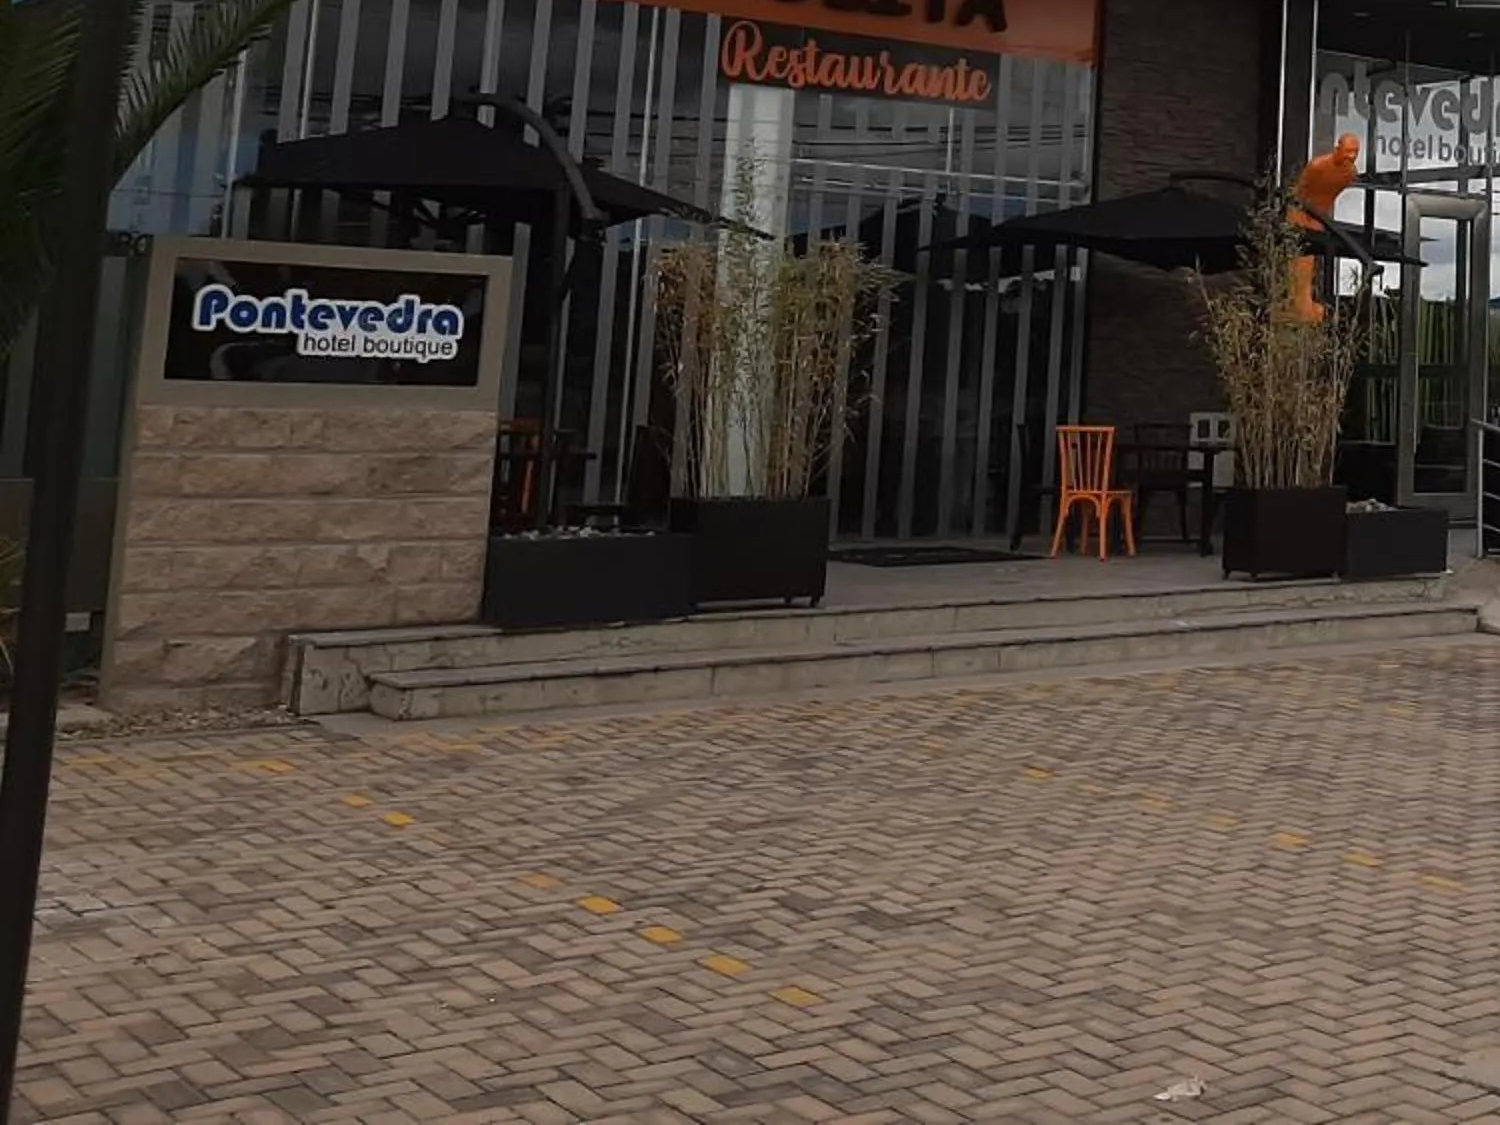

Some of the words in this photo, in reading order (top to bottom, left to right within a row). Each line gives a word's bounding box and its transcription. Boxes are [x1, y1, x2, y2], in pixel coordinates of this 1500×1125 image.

[721, 19, 992, 102] Restaurante
[194, 285, 463, 337] Pontevedra
[303, 332, 357, 353] hotel
[363, 338, 455, 361] boutique
